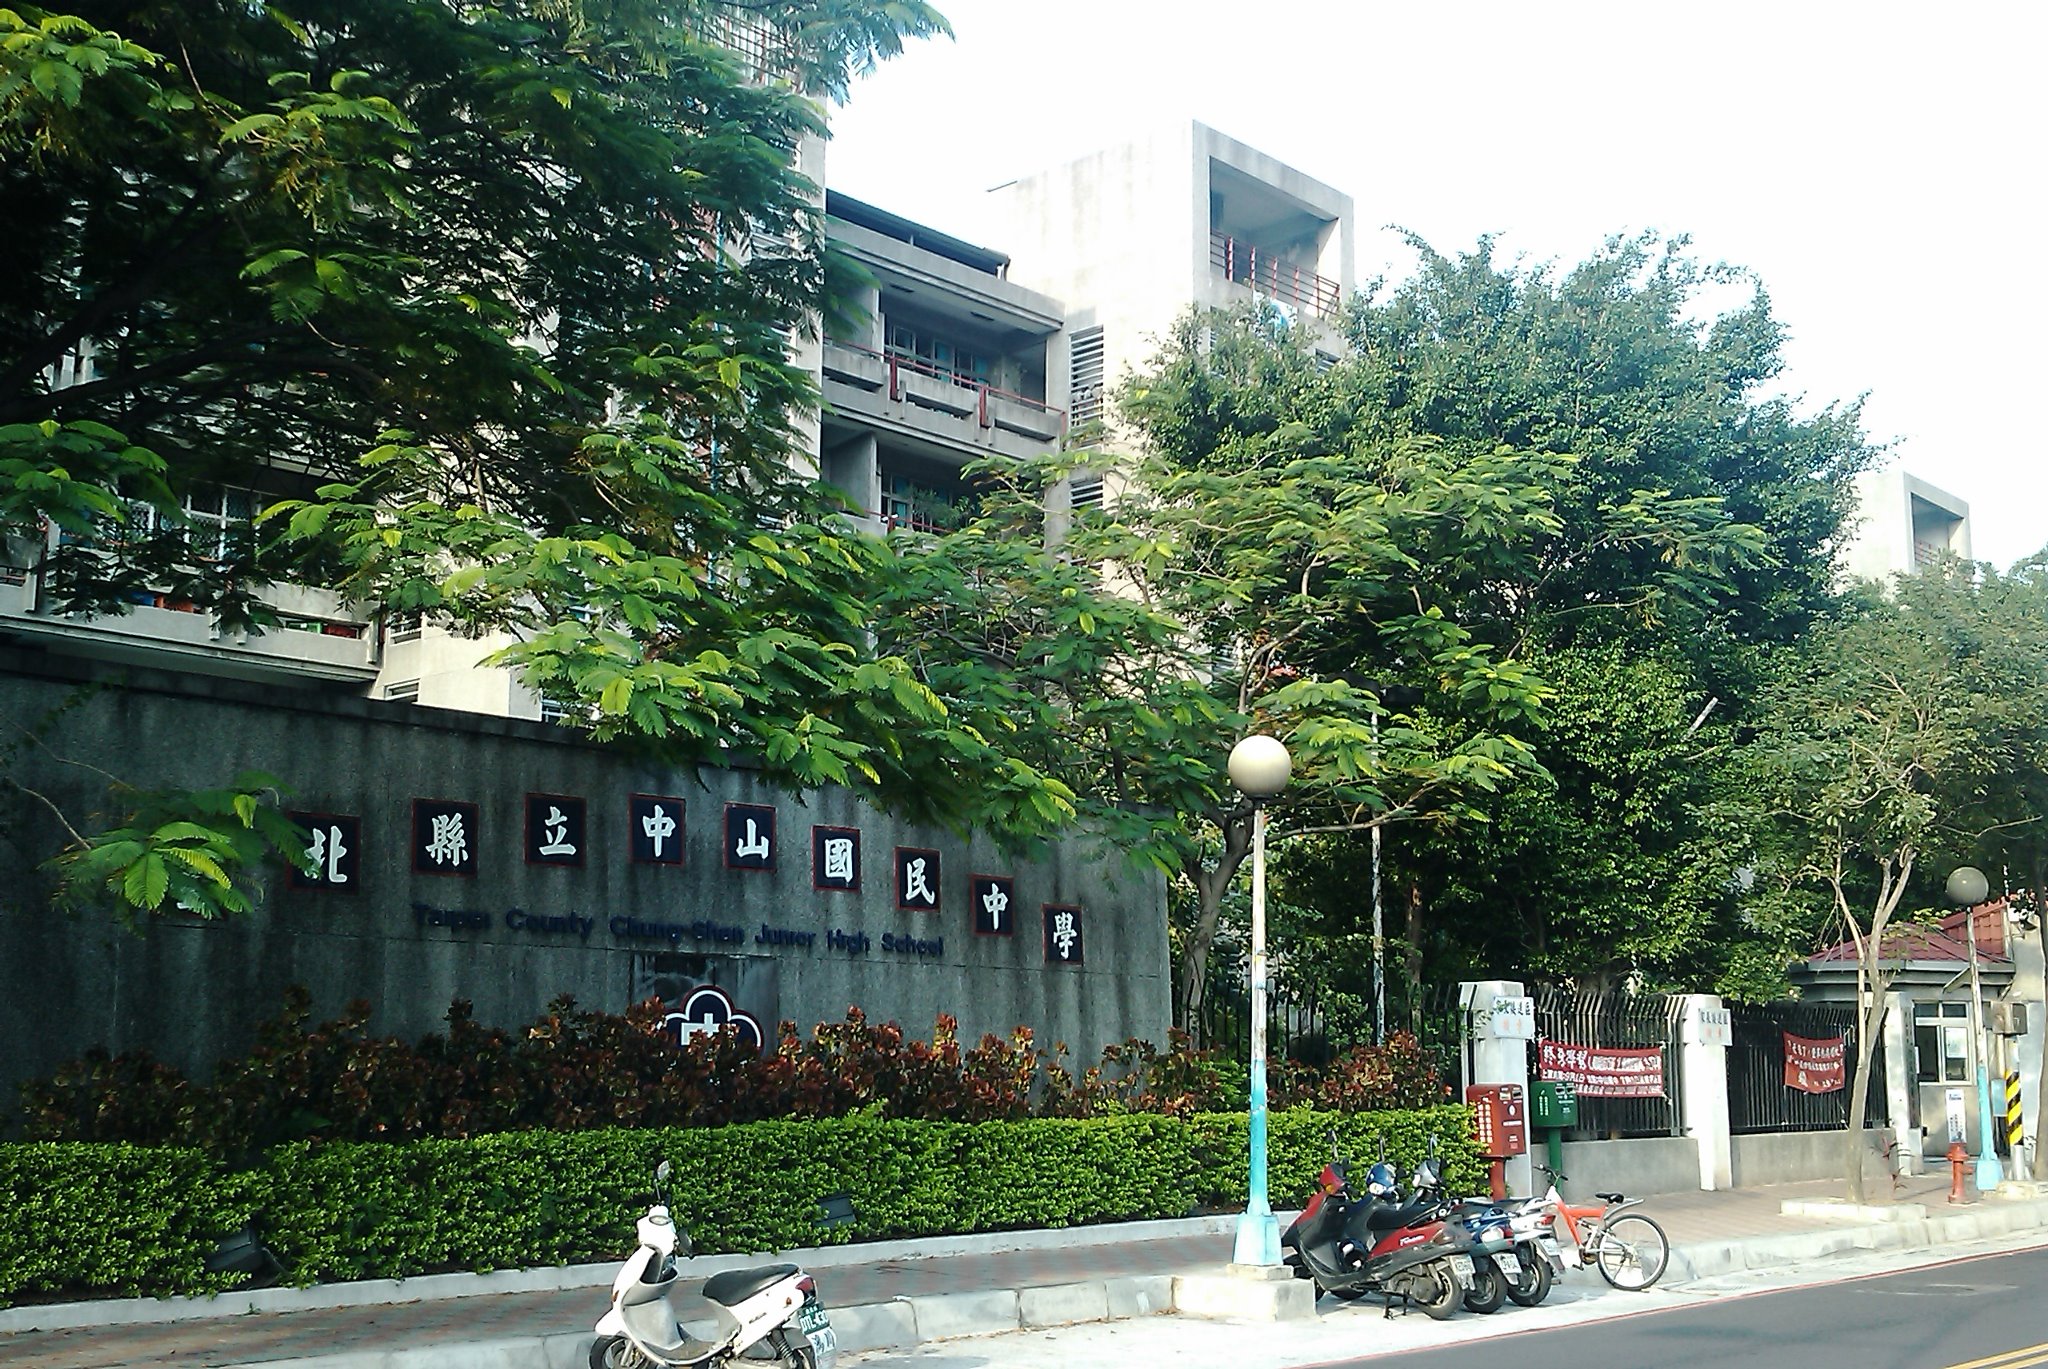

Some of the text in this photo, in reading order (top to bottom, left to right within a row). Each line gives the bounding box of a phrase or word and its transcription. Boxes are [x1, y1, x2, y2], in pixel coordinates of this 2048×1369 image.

[178, 804, 1078, 960] 北縣立中山國民中學
[506, 907, 594, 939] County
[609, 915, 684, 943] Chung
[755, 922, 817, 948] Junior
[827, 928, 871, 955] High
[881, 931, 944, 957] School
